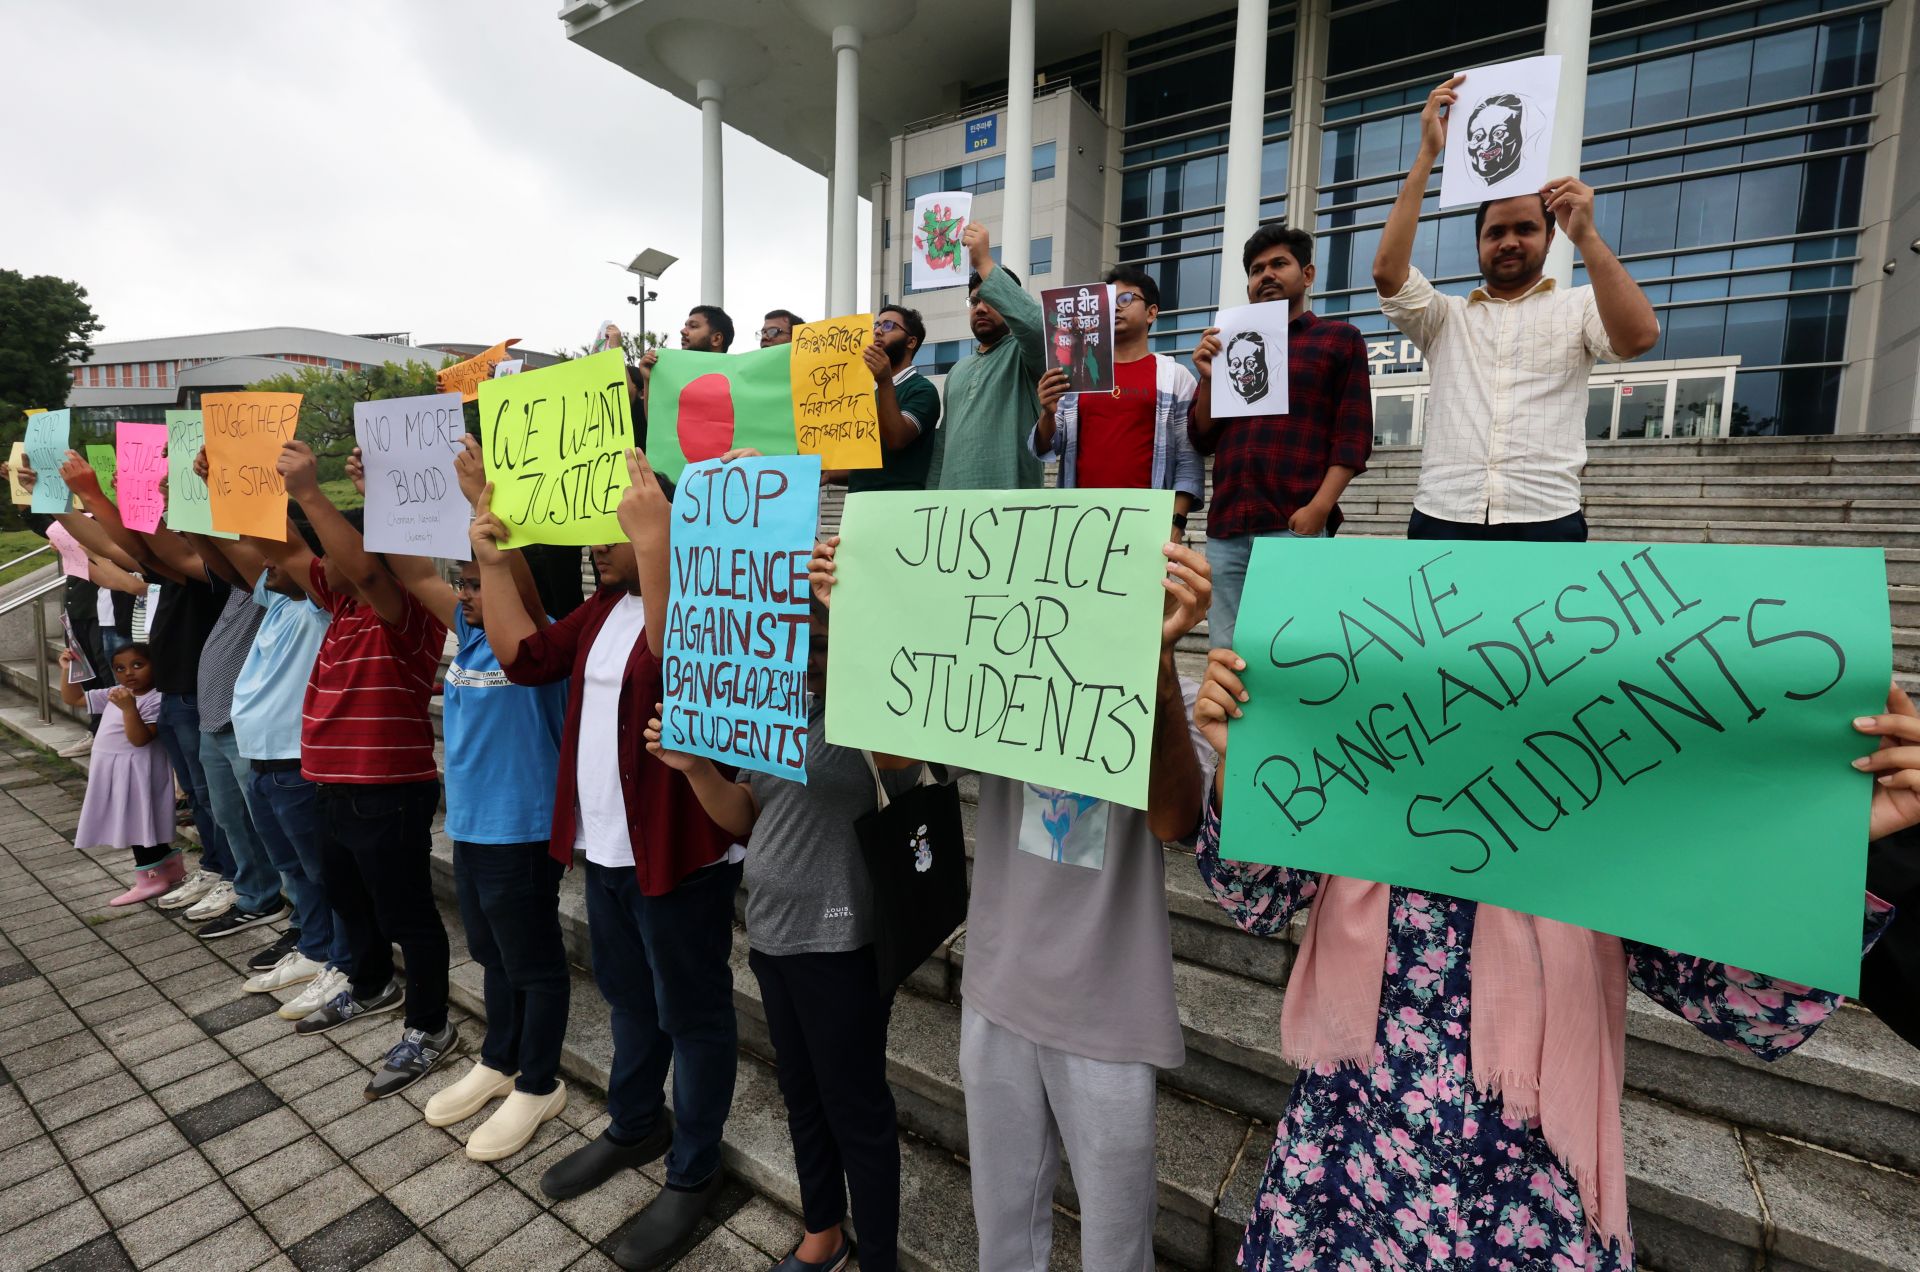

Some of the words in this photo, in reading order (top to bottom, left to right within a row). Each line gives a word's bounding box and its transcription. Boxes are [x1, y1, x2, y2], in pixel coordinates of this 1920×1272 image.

[974, 138, 988, 148] D19
[1055, 297, 1074, 314] বল
[1077, 287, 1099, 316] বীর
[206, 403, 298, 441] TOGETHER
[365, 415, 391, 455] NO
[405, 408, 461, 453] MORE
[492, 399, 547, 470] WE
[559, 381, 625, 460] WANT
[386, 466, 447, 506] BLOOD
[510, 450, 623, 526] JUSTICE
[682, 466, 788, 528] STOP
[674, 546, 811, 605] VIOLENCE
[896, 505, 1149, 596] JUSTICE
[667, 601, 811, 663] AGAINST
[964, 595, 1082, 686] FOR
[1270, 551, 1483, 706] SAVE
[666, 656, 807, 718] BANGLADESHI
[886, 646, 1149, 774] STUDENTS
[1253, 546, 1702, 837] BANGLADESHI
[672, 705, 808, 768] STUDENTS
[1406, 598, 1846, 874] STUDENTS
